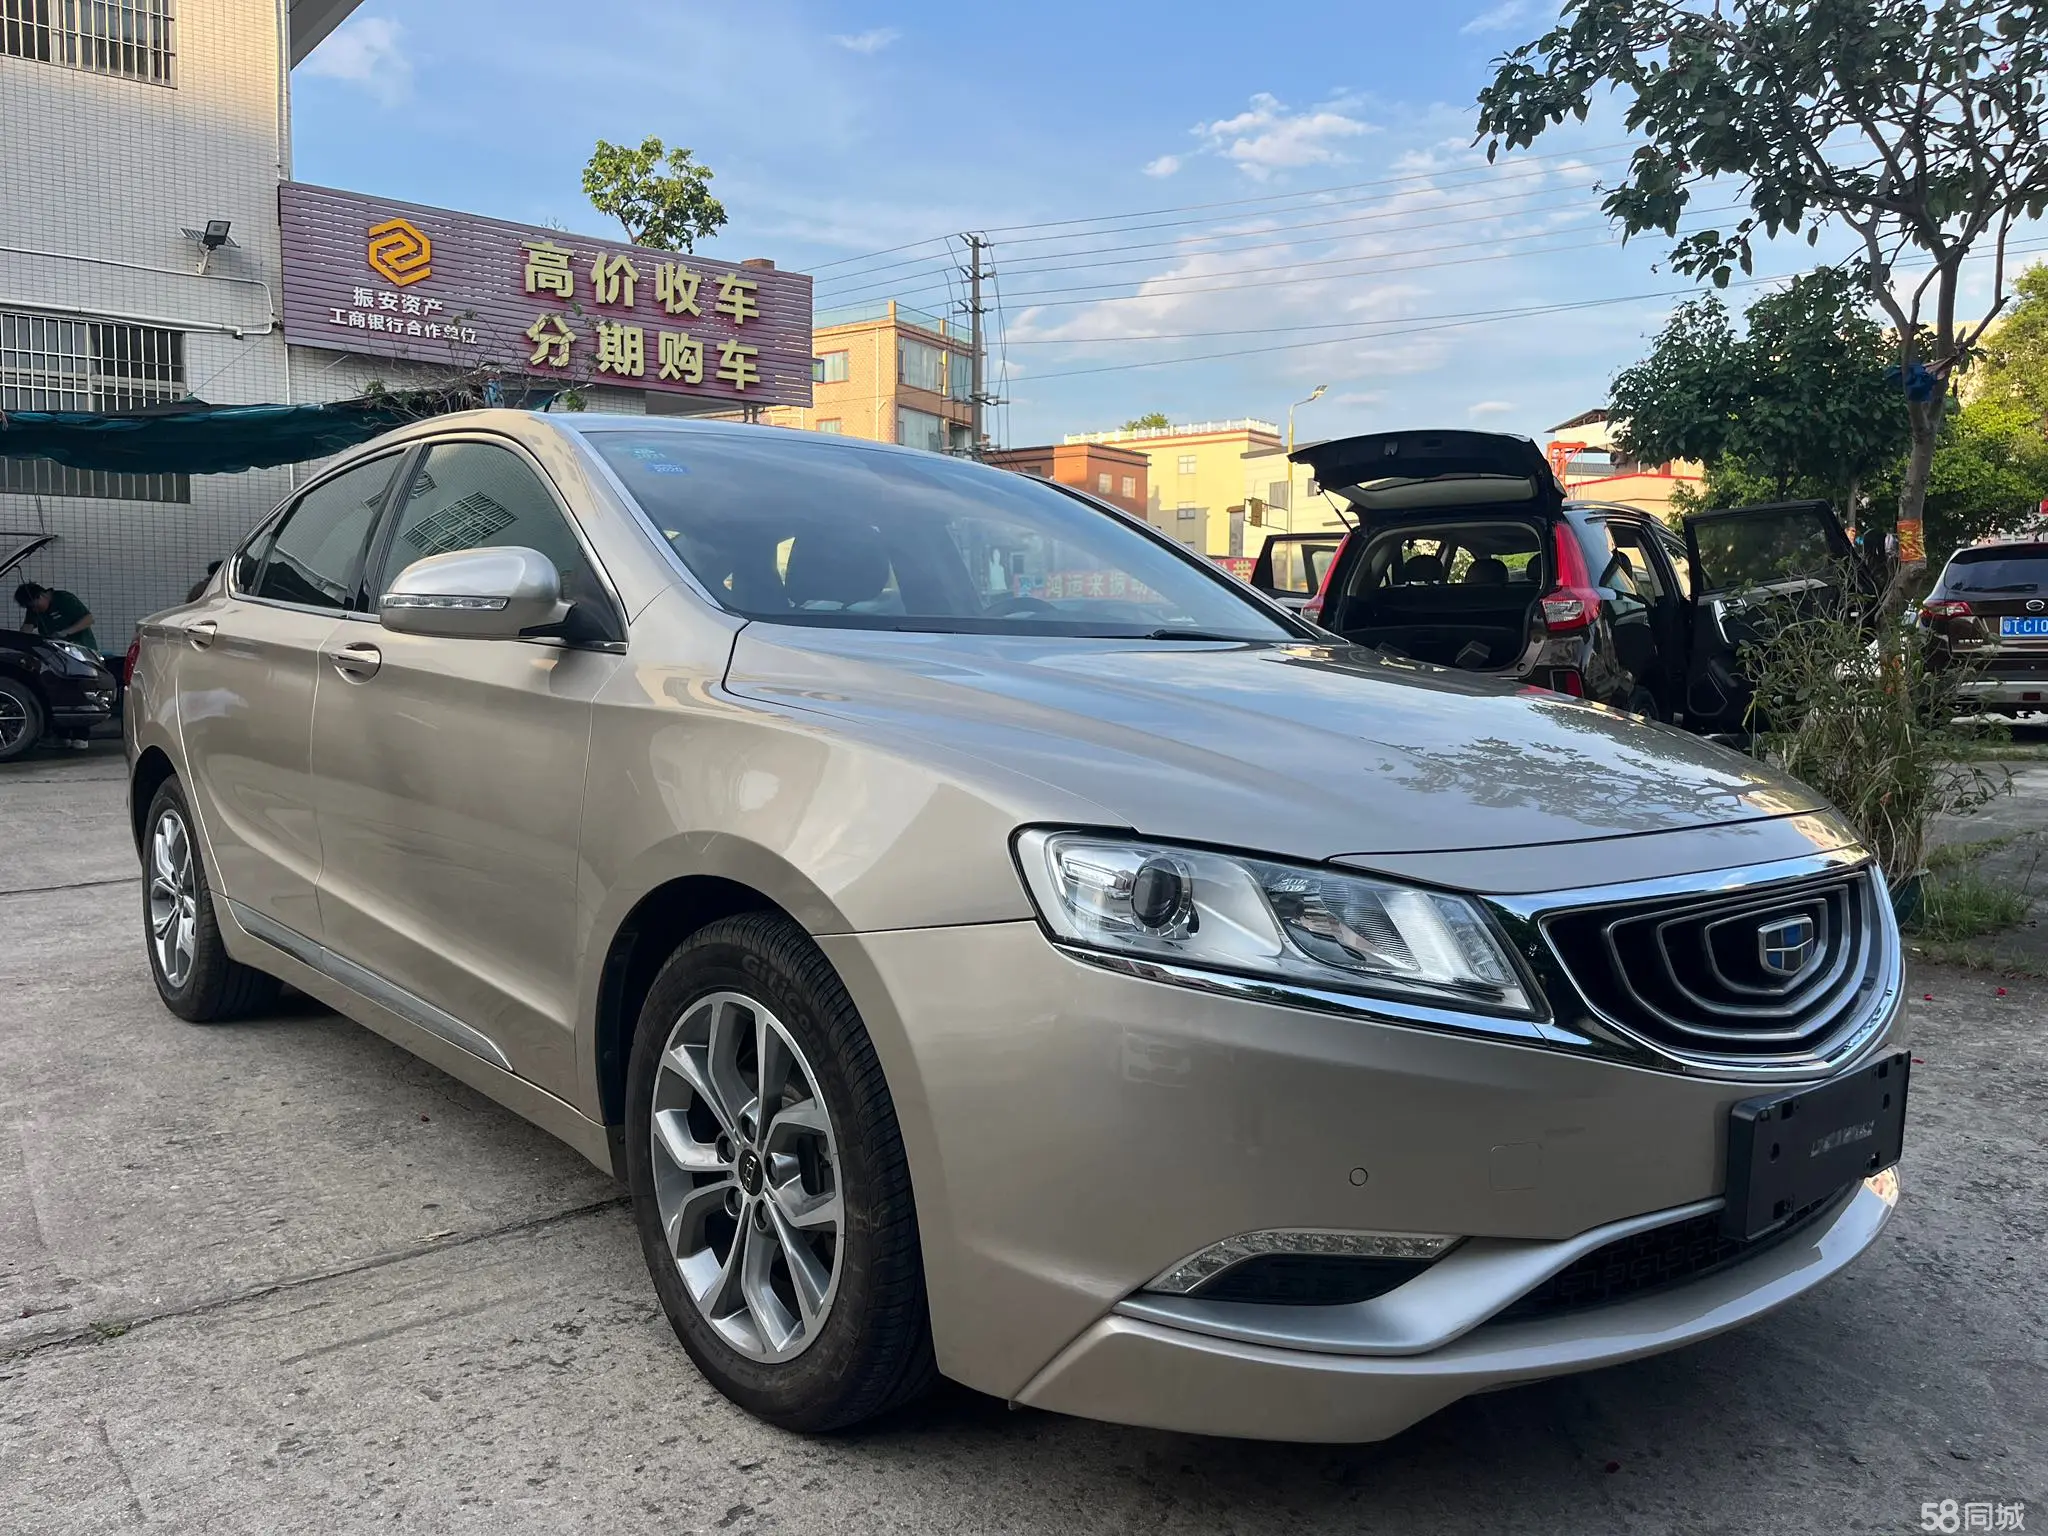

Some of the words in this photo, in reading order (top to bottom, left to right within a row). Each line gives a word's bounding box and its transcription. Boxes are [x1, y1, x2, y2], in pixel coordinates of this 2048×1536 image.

[352, 286, 443, 316] 振安资产
[522, 240, 760, 325] 高价收车
[329, 307, 478, 345] 工商银行合作单位
[525, 313, 761, 391] 分期购车
